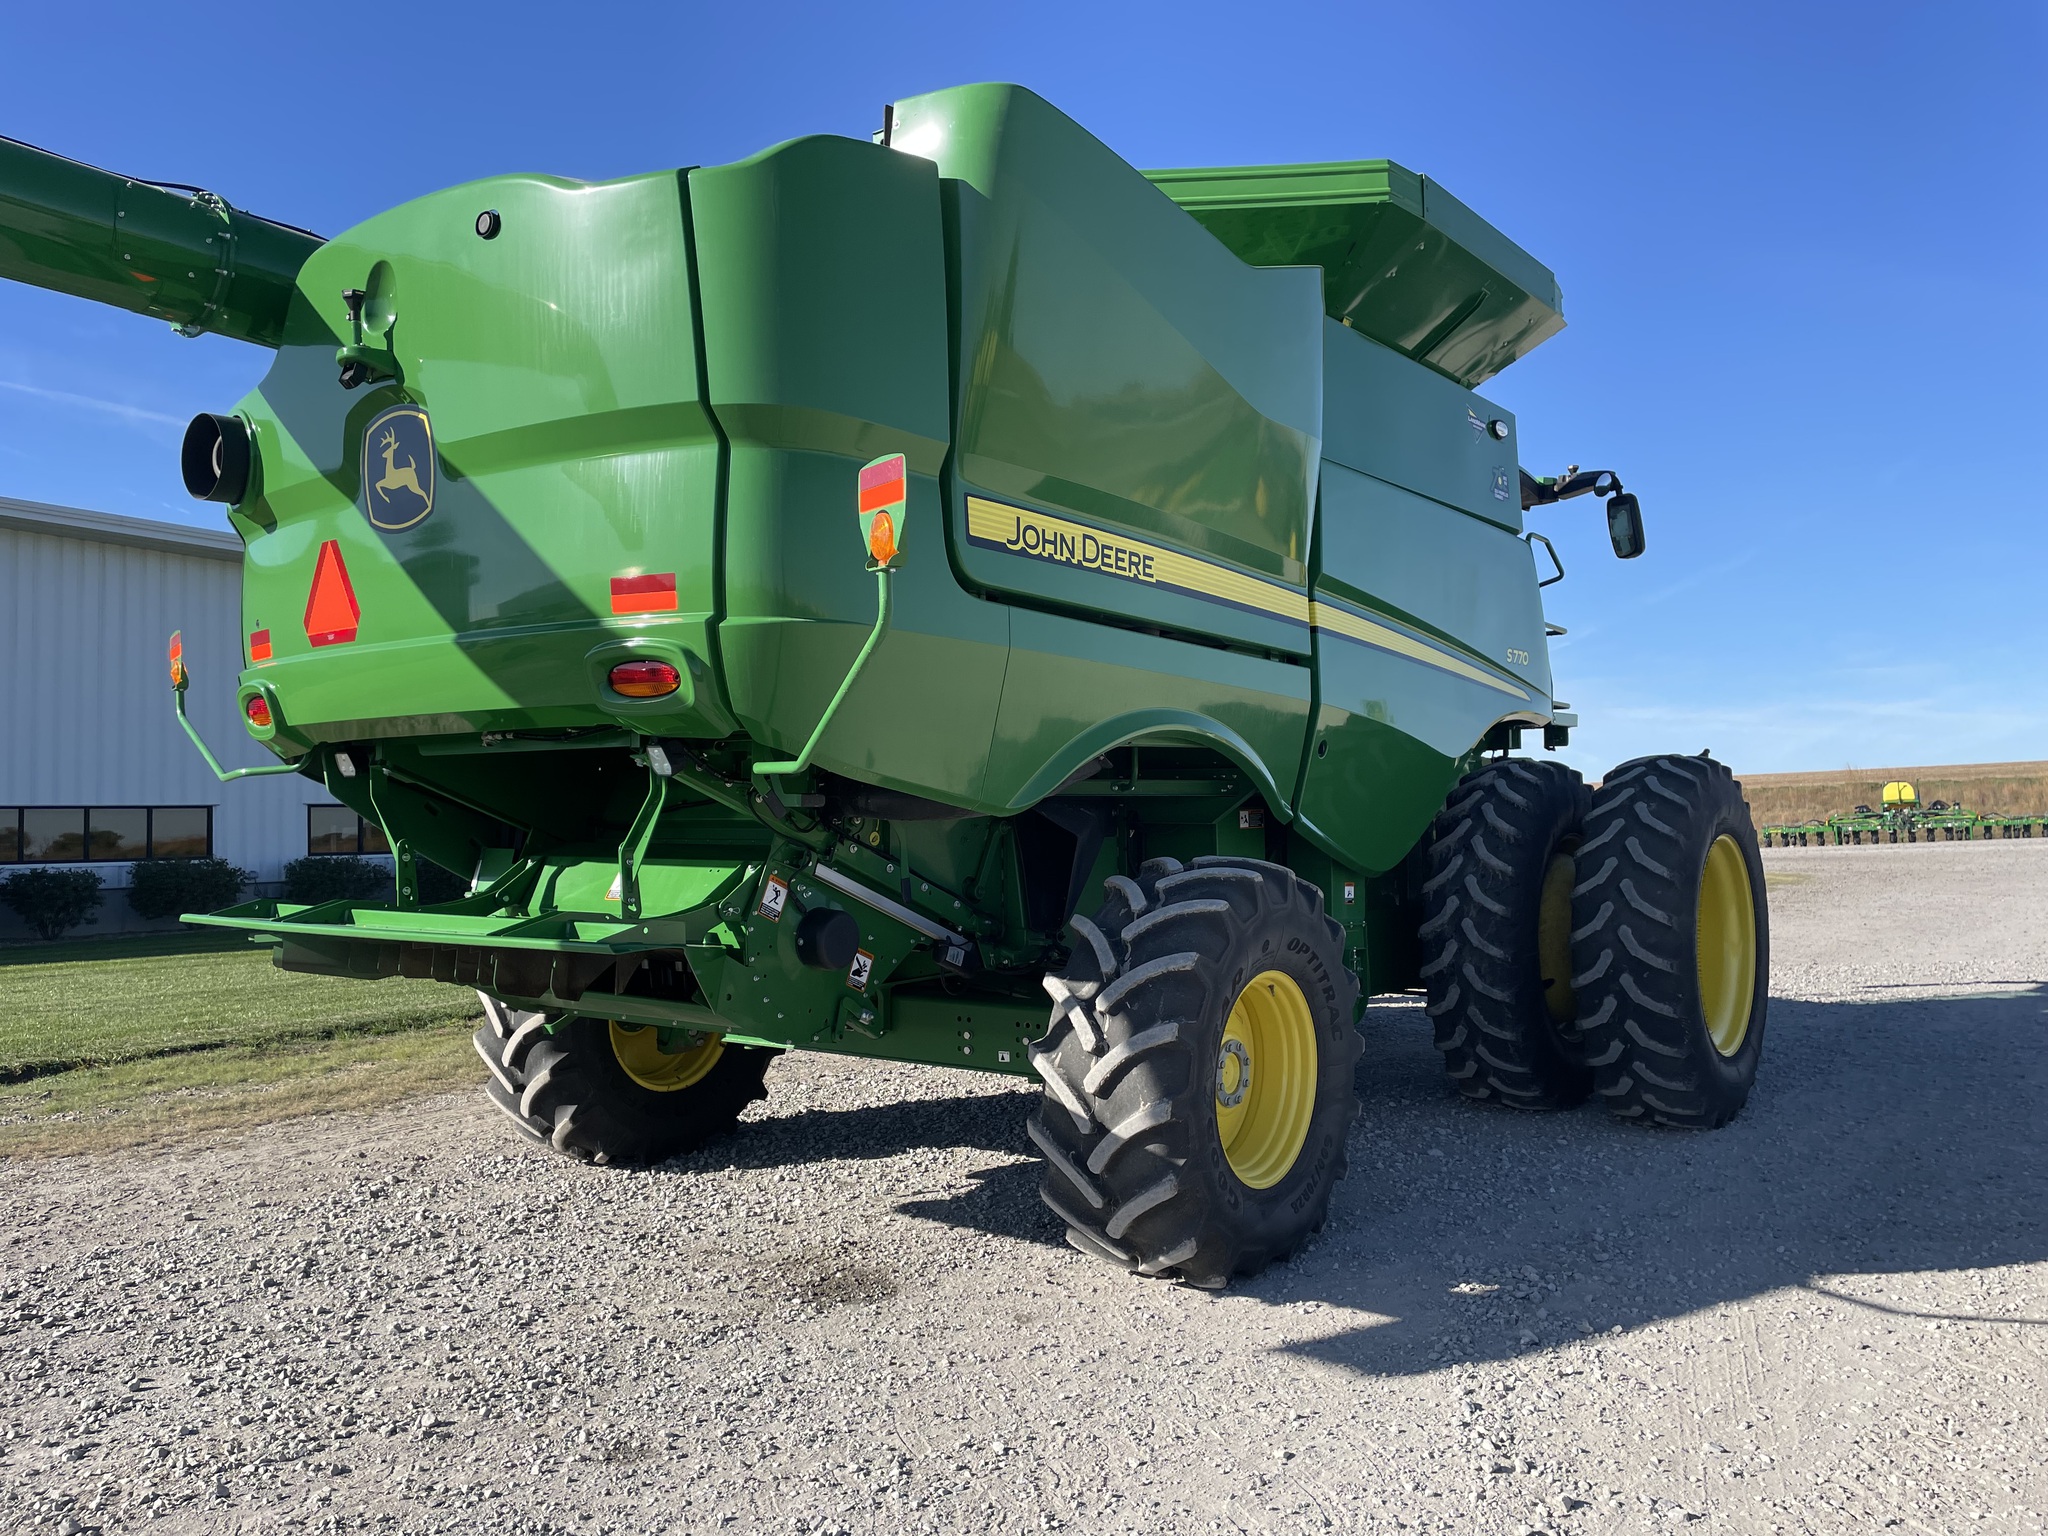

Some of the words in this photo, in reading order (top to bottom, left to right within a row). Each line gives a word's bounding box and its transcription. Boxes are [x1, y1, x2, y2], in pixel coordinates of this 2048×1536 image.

[1006, 516, 1076, 561] JOHN
[1082, 533, 1156, 581] DEERE
[1286, 937, 1343, 1042] OPTITRAC
